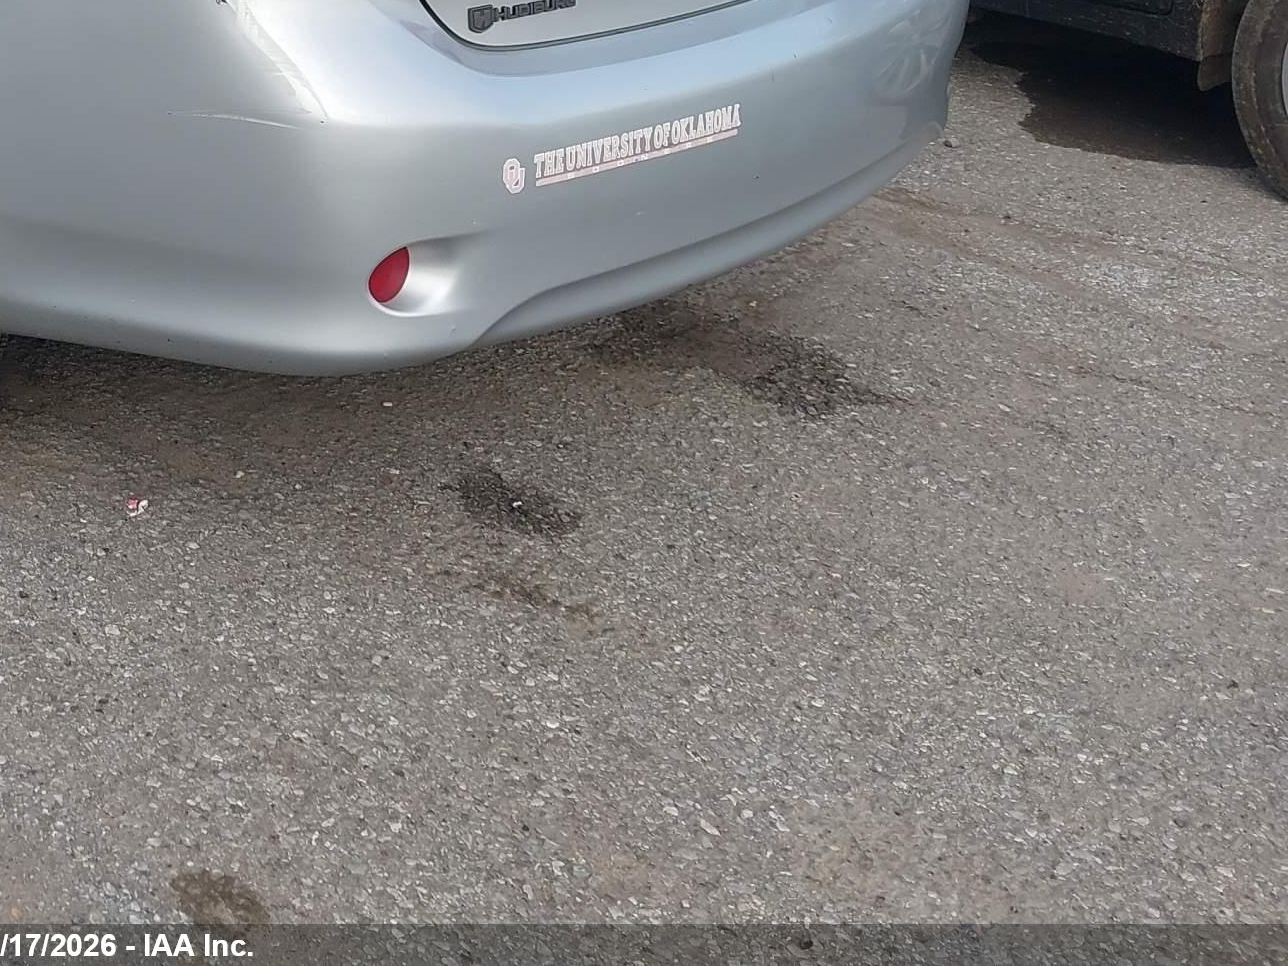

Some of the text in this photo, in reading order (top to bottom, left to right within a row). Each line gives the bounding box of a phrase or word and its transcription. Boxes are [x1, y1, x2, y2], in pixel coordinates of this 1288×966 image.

[534, 148, 565, 179] THE
[565, 126, 653, 172] UNIVERSITY
[653, 121, 671, 150] OF
[671, 103, 742, 145] OKLAHOMA
